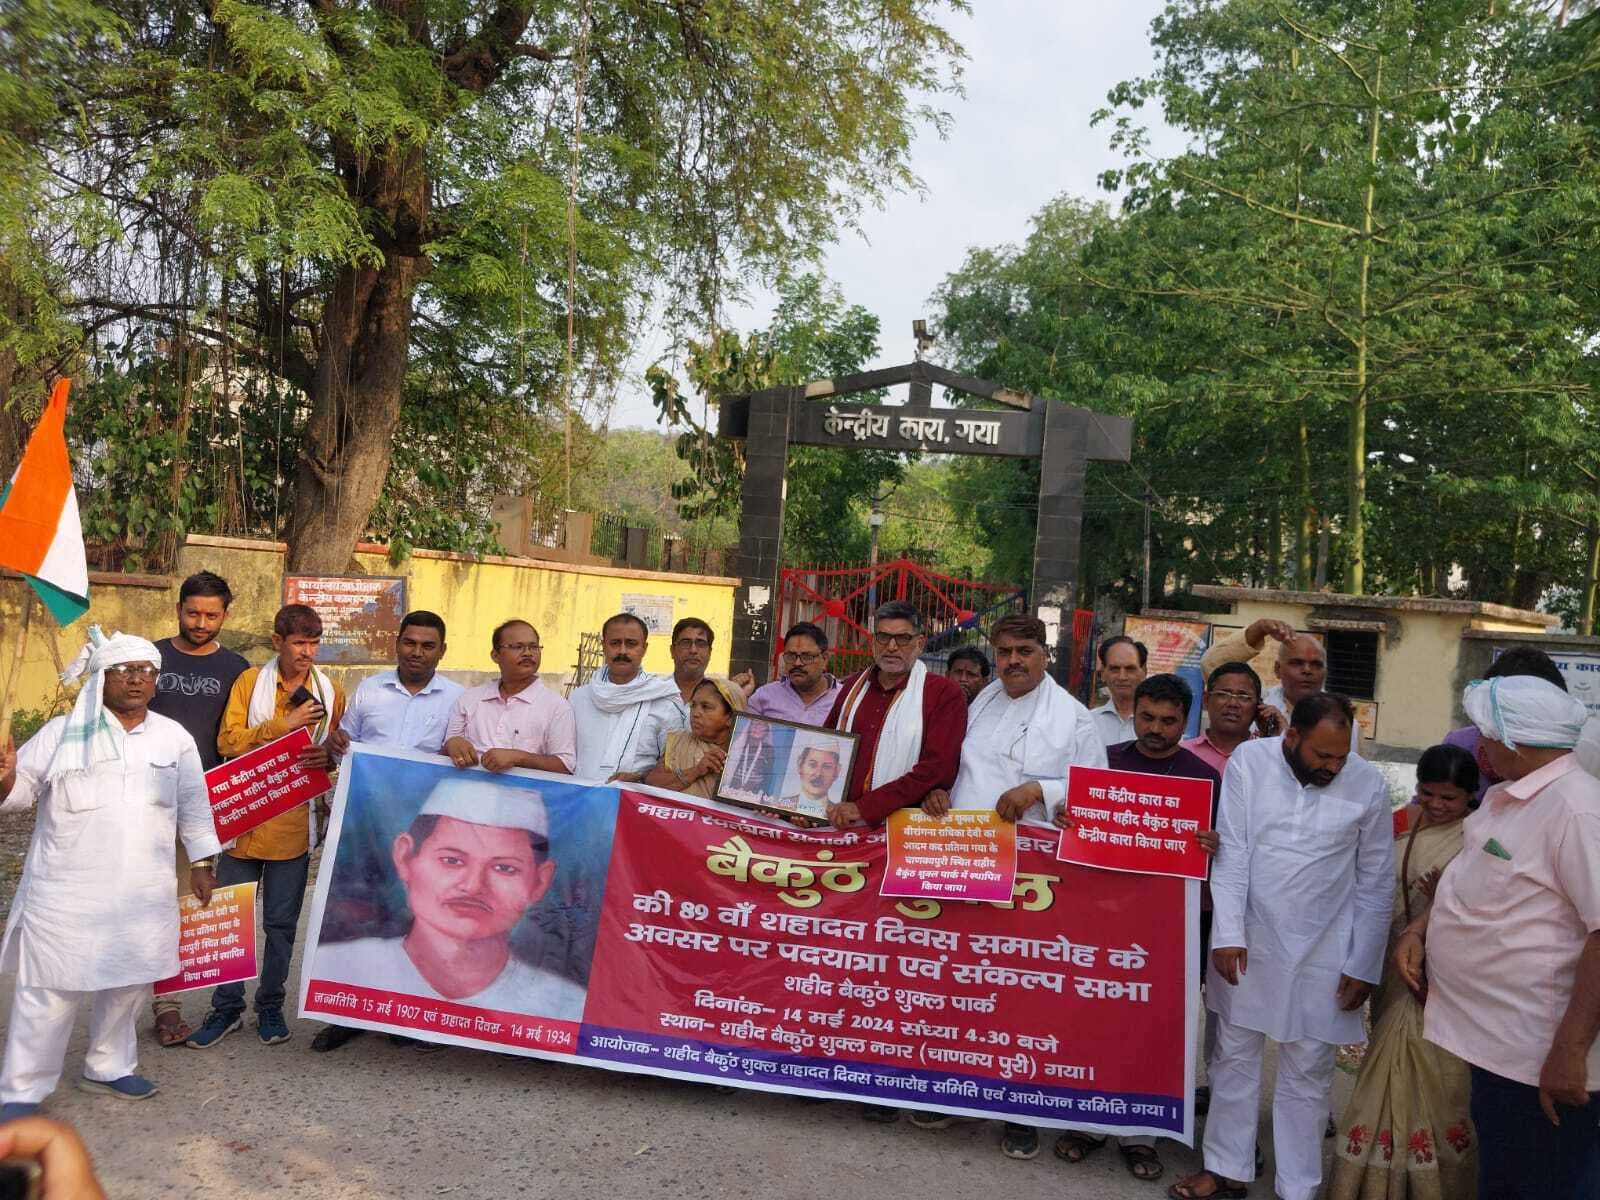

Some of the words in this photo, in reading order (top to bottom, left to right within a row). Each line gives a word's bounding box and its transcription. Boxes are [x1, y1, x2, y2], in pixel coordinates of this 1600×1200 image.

[824, 405, 890, 441] केन्द्रीय
[955, 419, 1001, 445] गया
[211, 781, 231, 794] गया
[256, 758, 277, 773] कारा
[277, 751, 290, 762] का
[243, 779, 267, 797] शहीद
[266, 770, 289, 785] बैकुंठ
[248, 796, 269, 811] कारा
[267, 784, 291, 801] किया
[291, 774, 311, 790] जाए
[637, 803, 696, 821] महान
[1088, 787, 1105, 799] गया
[1108, 786, 1136, 804] केंद्रीय
[1138, 793, 1162, 807] कारा
[1165, 796, 1180, 808] का
[984, 828, 996, 839] का
[1071, 805, 1110, 822] नामकरण
[1112, 810, 1140, 827] शहीद
[1142, 812, 1169, 830] बैकुंठ
[1171, 818, 1199, 834] शुक्ल
[1078, 825, 1108, 843] केन्द्रीय
[1109, 833, 1133, 846] कारा
[1135, 834, 1162, 849] किया
[1164, 839, 1187, 854] जाए
[971, 842, 988, 853] गया
[989, 841, 999, 853] के
[707, 835, 870, 908] बैकुंठ
[633, 890, 673, 916] की
[680, 902, 709, 921] 89
[718, 902, 757, 928] वाँ
[760, 912, 867, 941] शहादत
[875, 917, 960, 951] दिवस
[968, 934, 1099, 968] समारोह
[1107, 943, 1149, 970] के
[624, 922, 722, 953] अवसर
[728, 936, 771, 959] पर
[777, 942, 889, 974] पदयात्रा
[897, 954, 948, 980] एवं
[952, 959, 1066, 994] संकल्प
[1074, 976, 1152, 1002] सभा
[784, 973, 834, 997] शहीद
[838, 977, 890, 1008] बैकुंठ
[894, 988, 947, 1013] शुक्ल
[951, 992, 997, 1013] पार्क
[314, 991, 357, 1008] जन्मतिथि
[362, 998, 374, 1013] 15
[376, 999, 392, 1015] मई
[396, 1003, 421, 1020] 1907
[423, 1007, 437, 1022] एवं
[441, 1012, 471, 1029] शहादत
[510, 1024, 523, 1038] 14
[525, 1026, 542, 1041] मई
[546, 1031, 571, 1046] 1934
[694, 989, 776, 1016] दिनांक-
[783, 1007, 803, 1022] 14
[808, 1008, 845, 1028] मई
[851, 1014, 895, 1033] 2024
[900, 1020, 960, 1041] संध्या
[964, 1028, 1010, 1046] 4.30
[1016, 1033, 1060, 1054] बजे
[660, 1012, 715, 1032] स्थान-
[719, 1020, 768, 1041] शहीद
[770, 1024, 815, 1052] बैकुंठ
[819, 1036, 865, 1056] शुक्ल
[870, 1039, 914, 1059] नगर
[919, 1041, 993, 1069] (चाणक्य
[998, 1053, 1037, 1080] पुरी)
[590, 1033, 660, 1054] आयोजक-
[663, 1044, 701, 1062] शहीद
[704, 1049, 739, 1073] बैकुंठ
[741, 1058, 776, 1075] शुक्ल
[780, 1062, 829, 1079] शहादत
[833, 1064, 871, 1085] दिवस
[874, 1074, 928, 1092] समारोह
[932, 1078, 978, 1099] समिति
[983, 1087, 1006, 1102] एवं
[1008, 1091, 1074, 1110] आयोजन
[1077, 1096, 1127, 1115] समिति
[1130, 1103, 1164, 1117] गया
